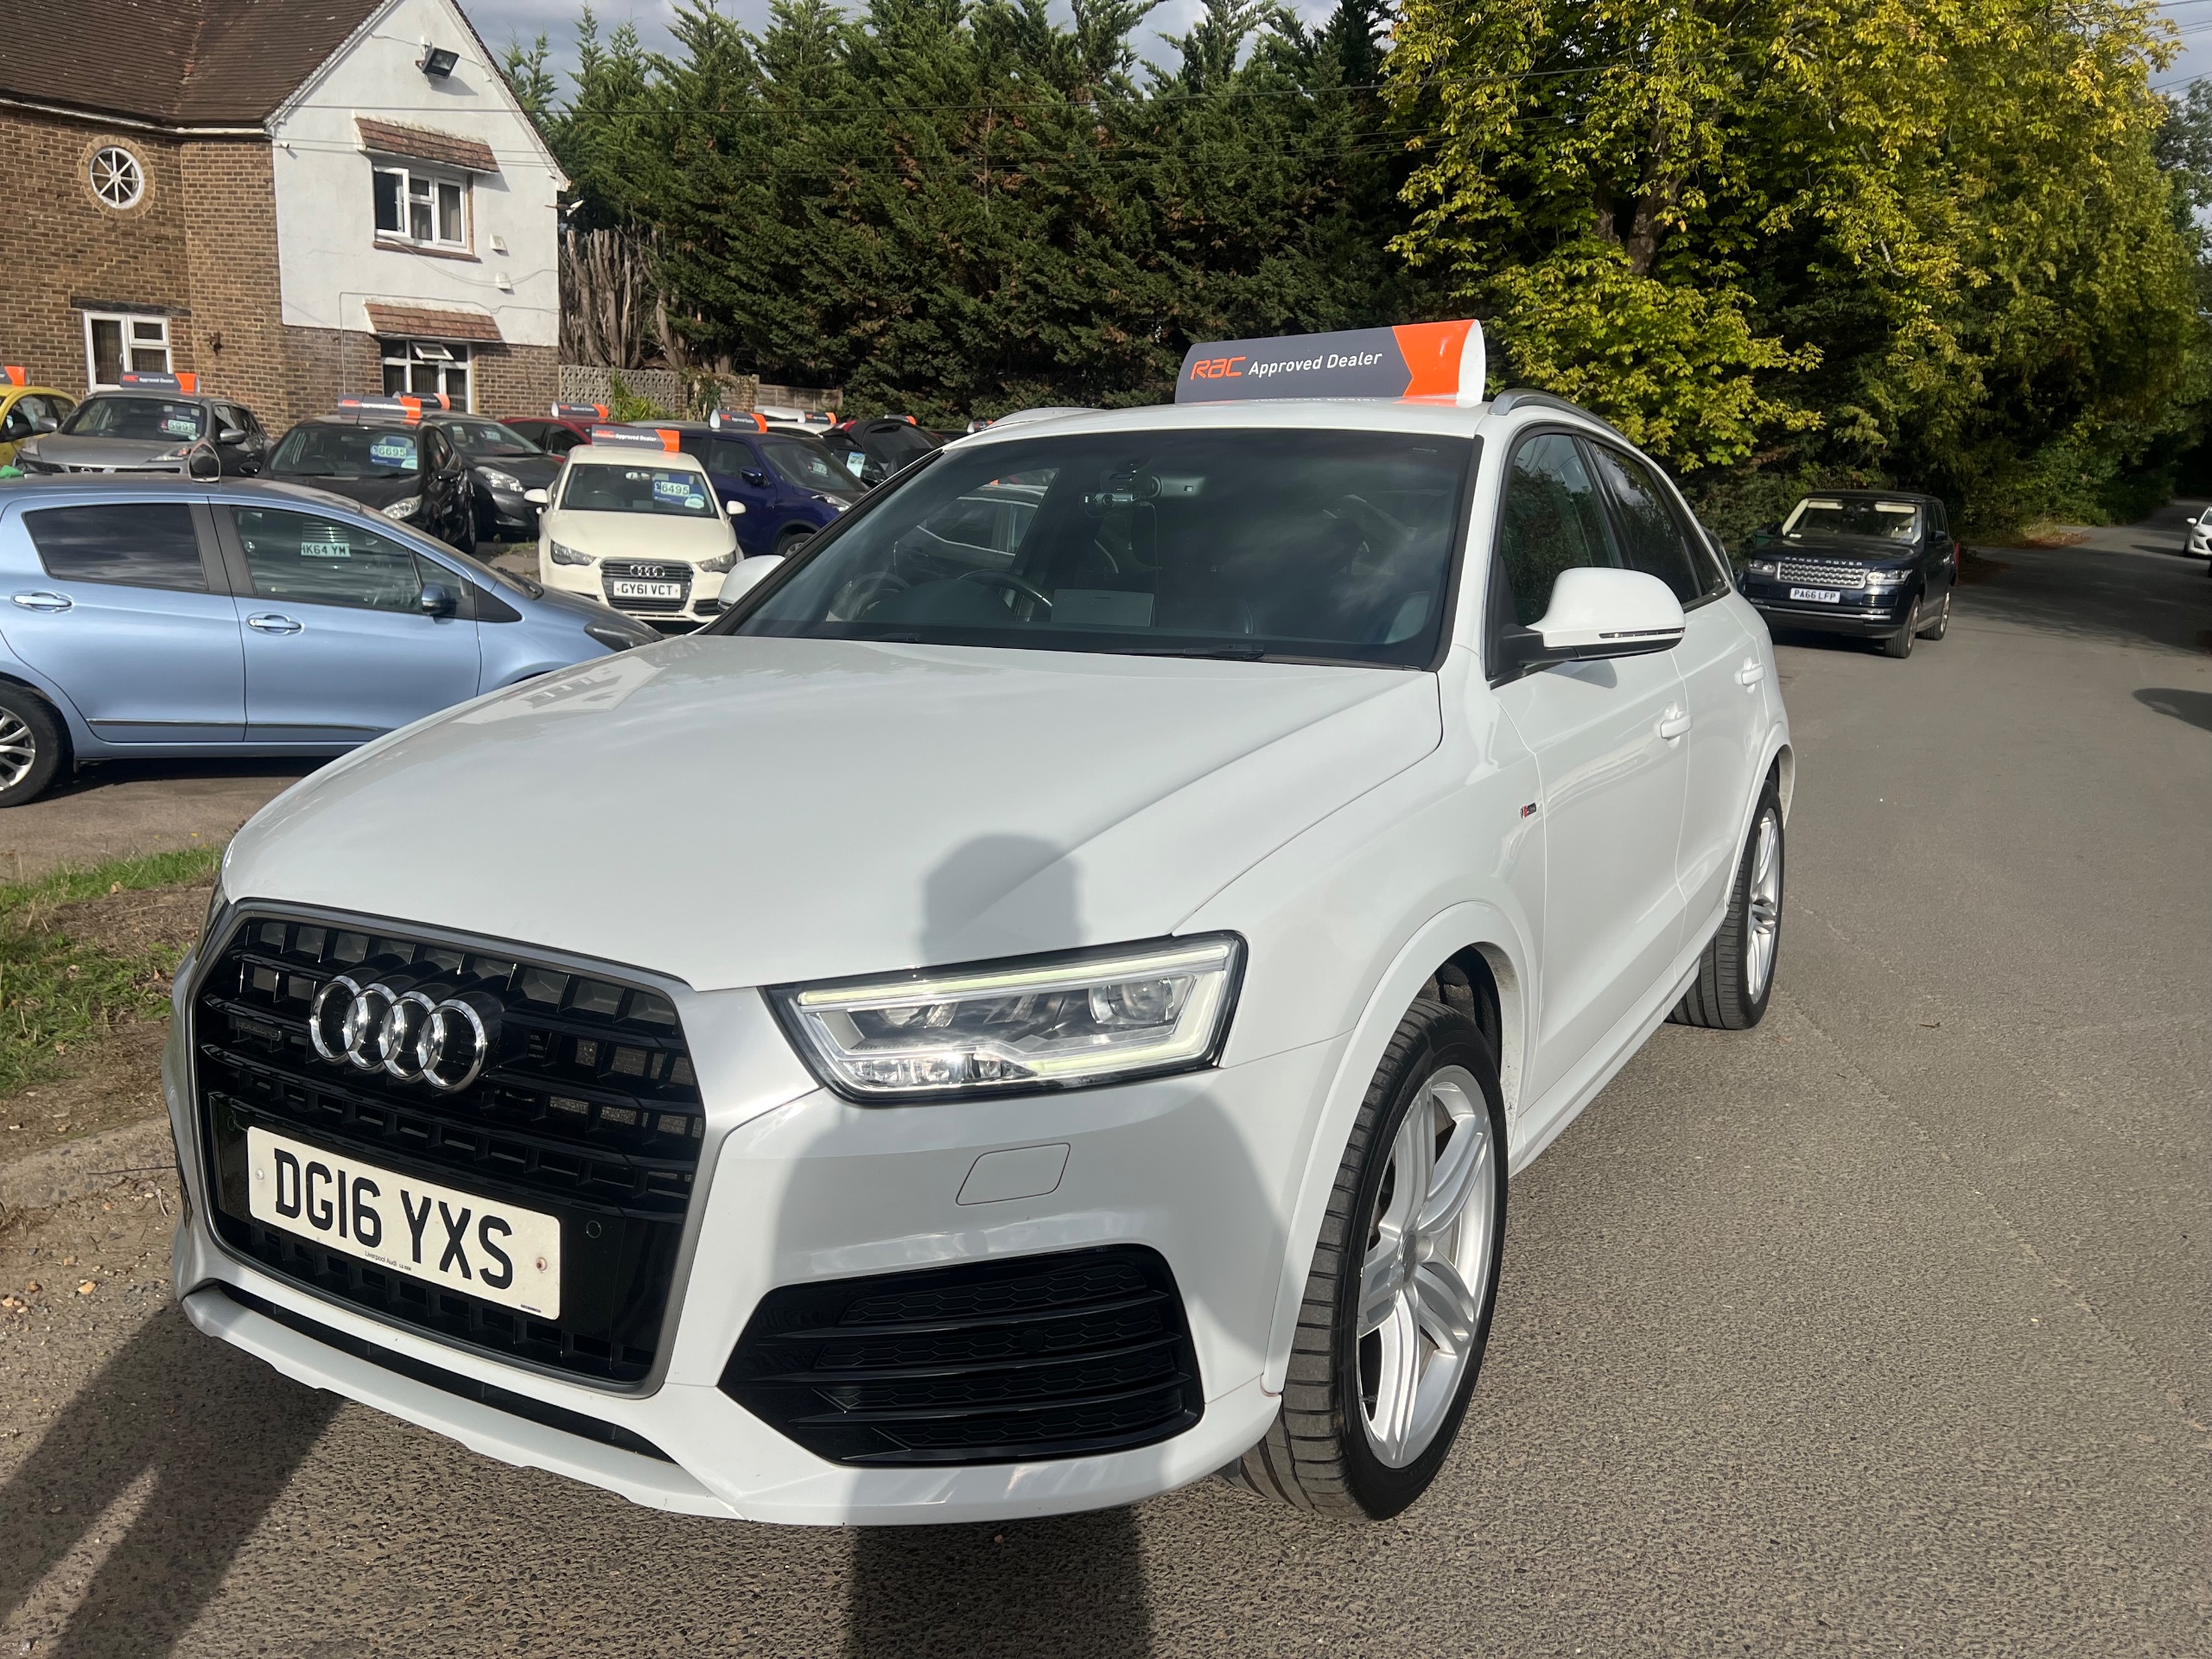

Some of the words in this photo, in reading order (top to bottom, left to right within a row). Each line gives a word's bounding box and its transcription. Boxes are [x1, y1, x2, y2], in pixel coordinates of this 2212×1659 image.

[1248, 355, 1323, 378] Approved
[1326, 352, 1382, 368] Dealer
[621, 582, 648, 594] GY61
[650, 585, 673, 595] VCT
[1794, 589, 1816, 599] PA66
[1818, 592, 1836, 601] LFP
[274, 1147, 382, 1249] DG16
[400, 1189, 513, 1290] YXS
[365, 1249, 386, 1262] Liverpool
[385, 1257, 397, 1267] Audi
